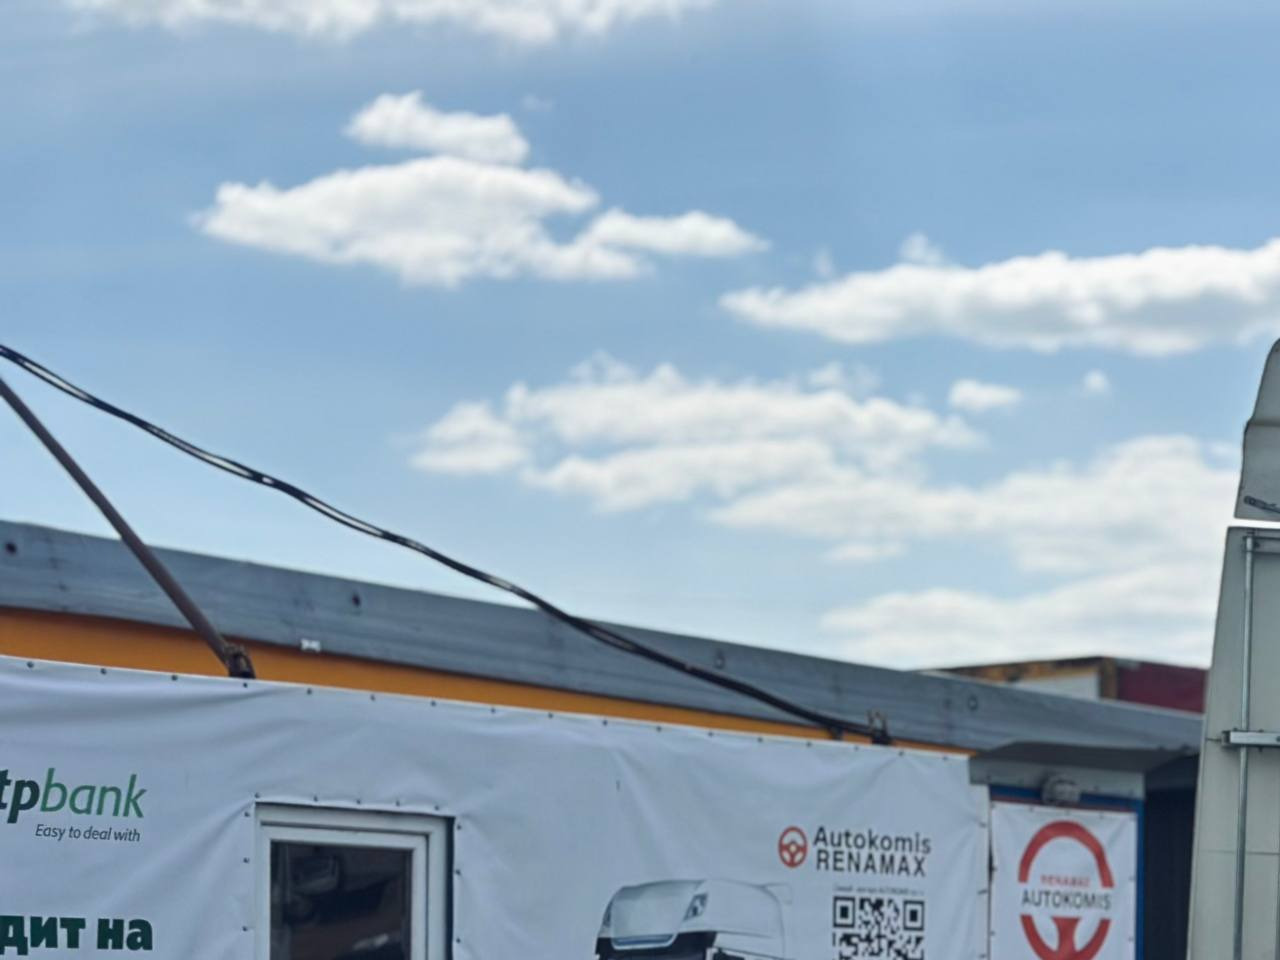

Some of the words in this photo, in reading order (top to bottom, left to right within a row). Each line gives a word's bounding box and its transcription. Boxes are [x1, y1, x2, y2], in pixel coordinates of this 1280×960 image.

[36, 824, 65, 841] Easy
[69, 826, 81, 838] to
[83, 826, 112, 840] deal
[114, 828, 140, 842] with
[813, 826, 931, 854] Autokomis
[816, 849, 926, 877] RENAMAX
[1022, 889, 1112, 910] AUTOKOMIS
[97, 918, 153, 950] на
